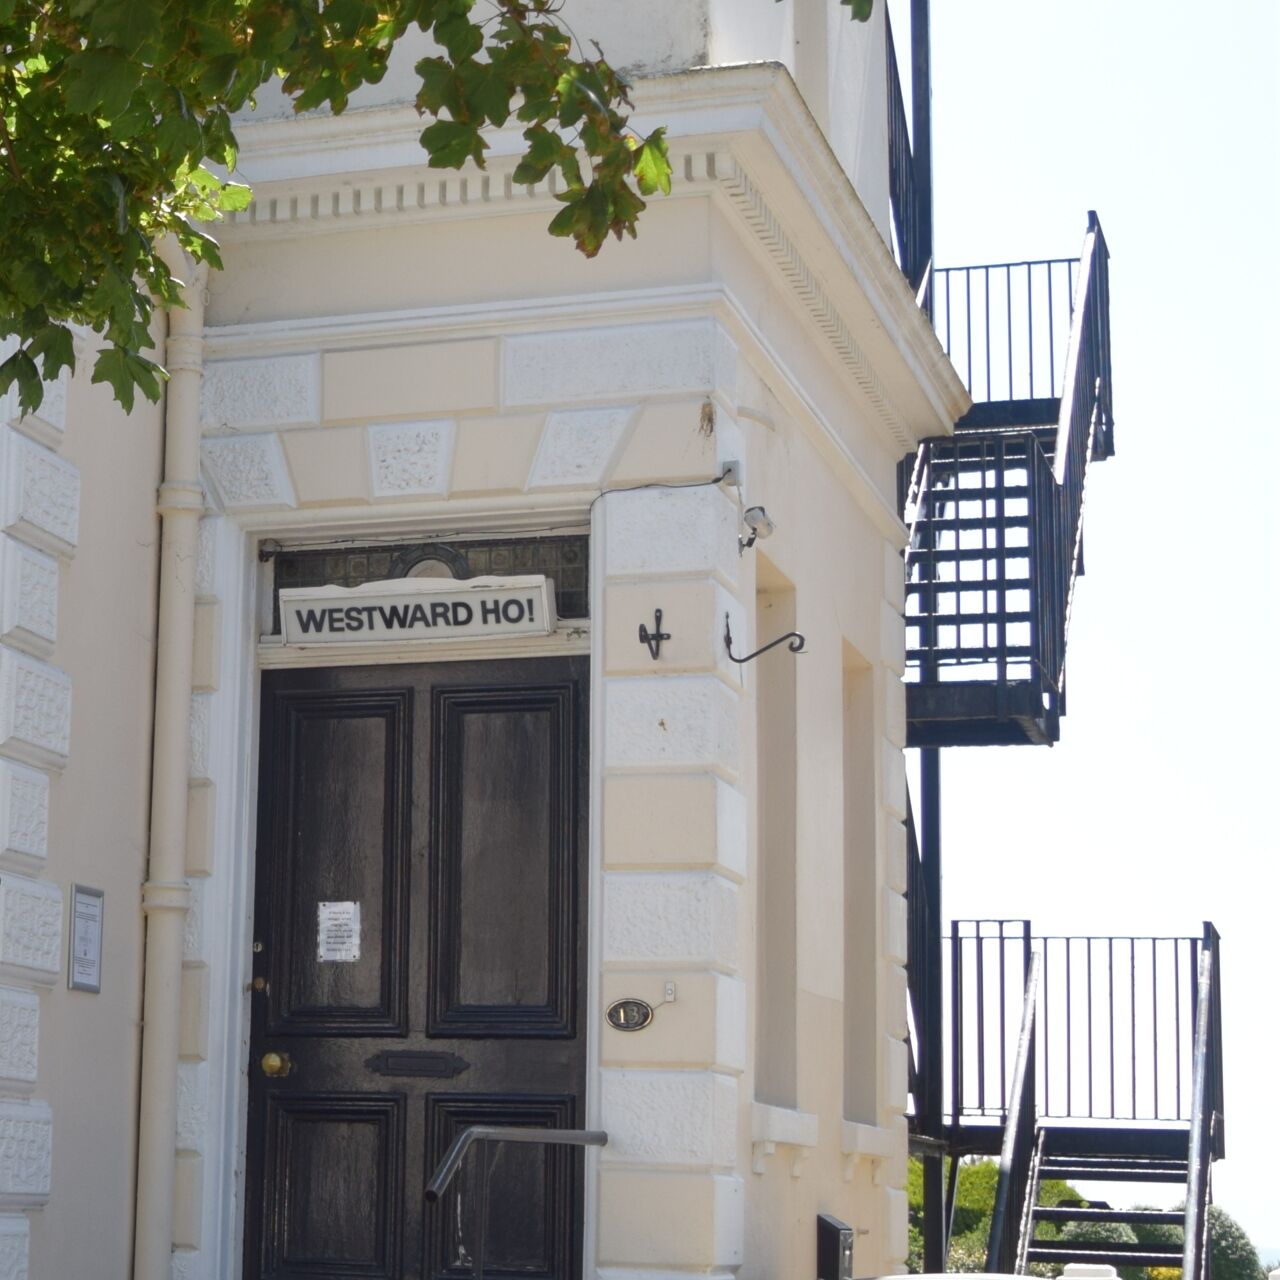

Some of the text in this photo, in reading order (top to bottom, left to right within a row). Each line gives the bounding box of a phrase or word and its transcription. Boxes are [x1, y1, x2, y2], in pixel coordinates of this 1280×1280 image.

[296, 599, 535, 634] WESTWARD HO!
[618, 1006, 640, 1024] 13
